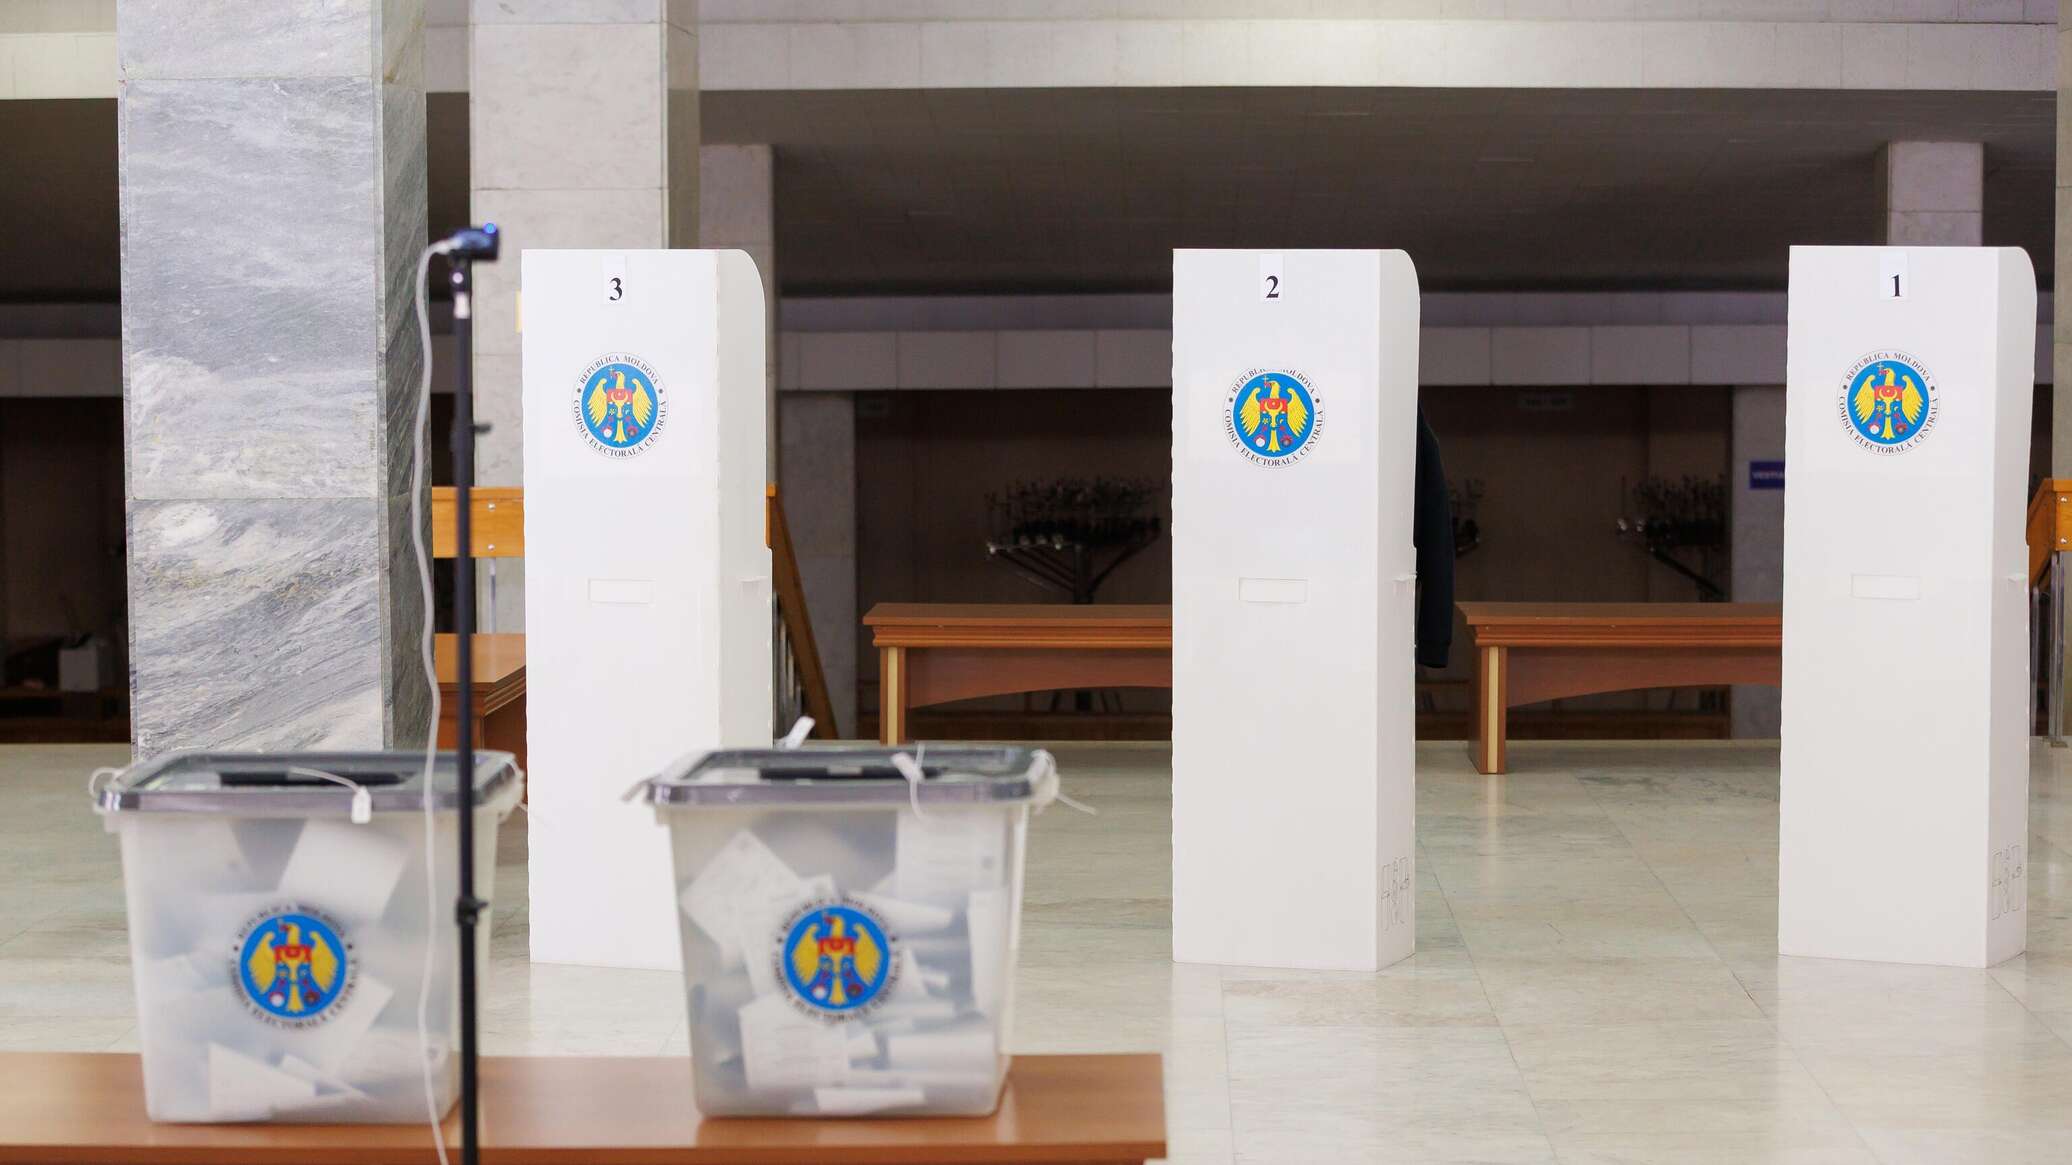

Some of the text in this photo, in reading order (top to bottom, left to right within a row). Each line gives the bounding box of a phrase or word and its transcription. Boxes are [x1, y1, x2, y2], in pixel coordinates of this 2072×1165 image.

[609, 277, 623, 301] 3
[1265, 275, 1280, 299] 2
[1890, 274, 1904, 298] 1
[579, 355, 658, 385] REPUBLICA MOLDOVA
[1846, 352, 1931, 381] REPUBLICA MOLDOVA
[573, 399, 589, 439] COMISIA
[1225, 409, 1240, 448] COMISIA
[1839, 396, 1854, 435] COMISIA
